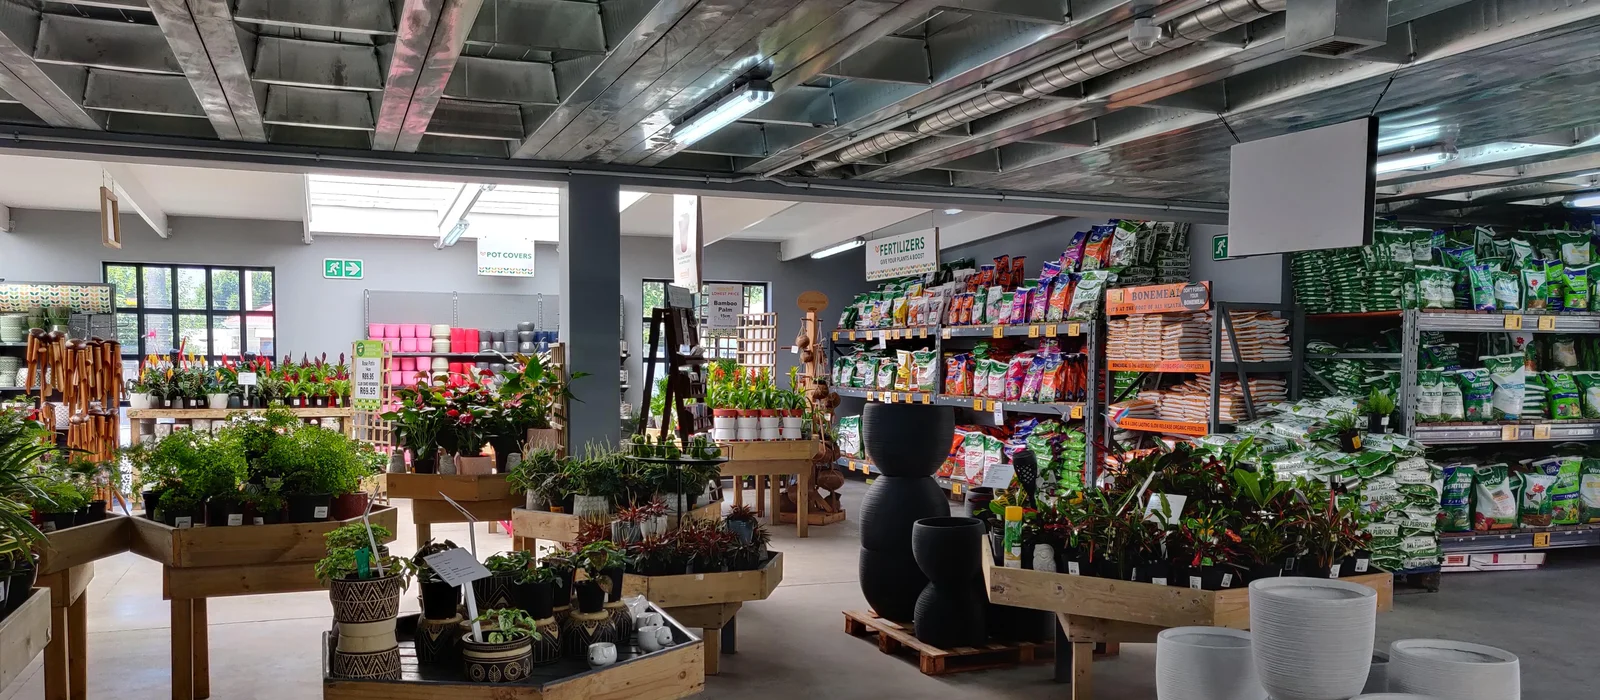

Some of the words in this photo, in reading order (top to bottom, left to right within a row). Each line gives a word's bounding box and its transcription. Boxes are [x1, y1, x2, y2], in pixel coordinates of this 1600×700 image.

[880, 236, 925, 256] FERTILIZERS
[502, 252, 532, 260] COVERS
[880, 257, 888, 265] GIVE
[888, 256, 897, 264] YOUR
[897, 255, 909, 263] PLANTS
[912, 253, 925, 261] BOOST
[1132, 289, 1180, 301] BONEMEAL
